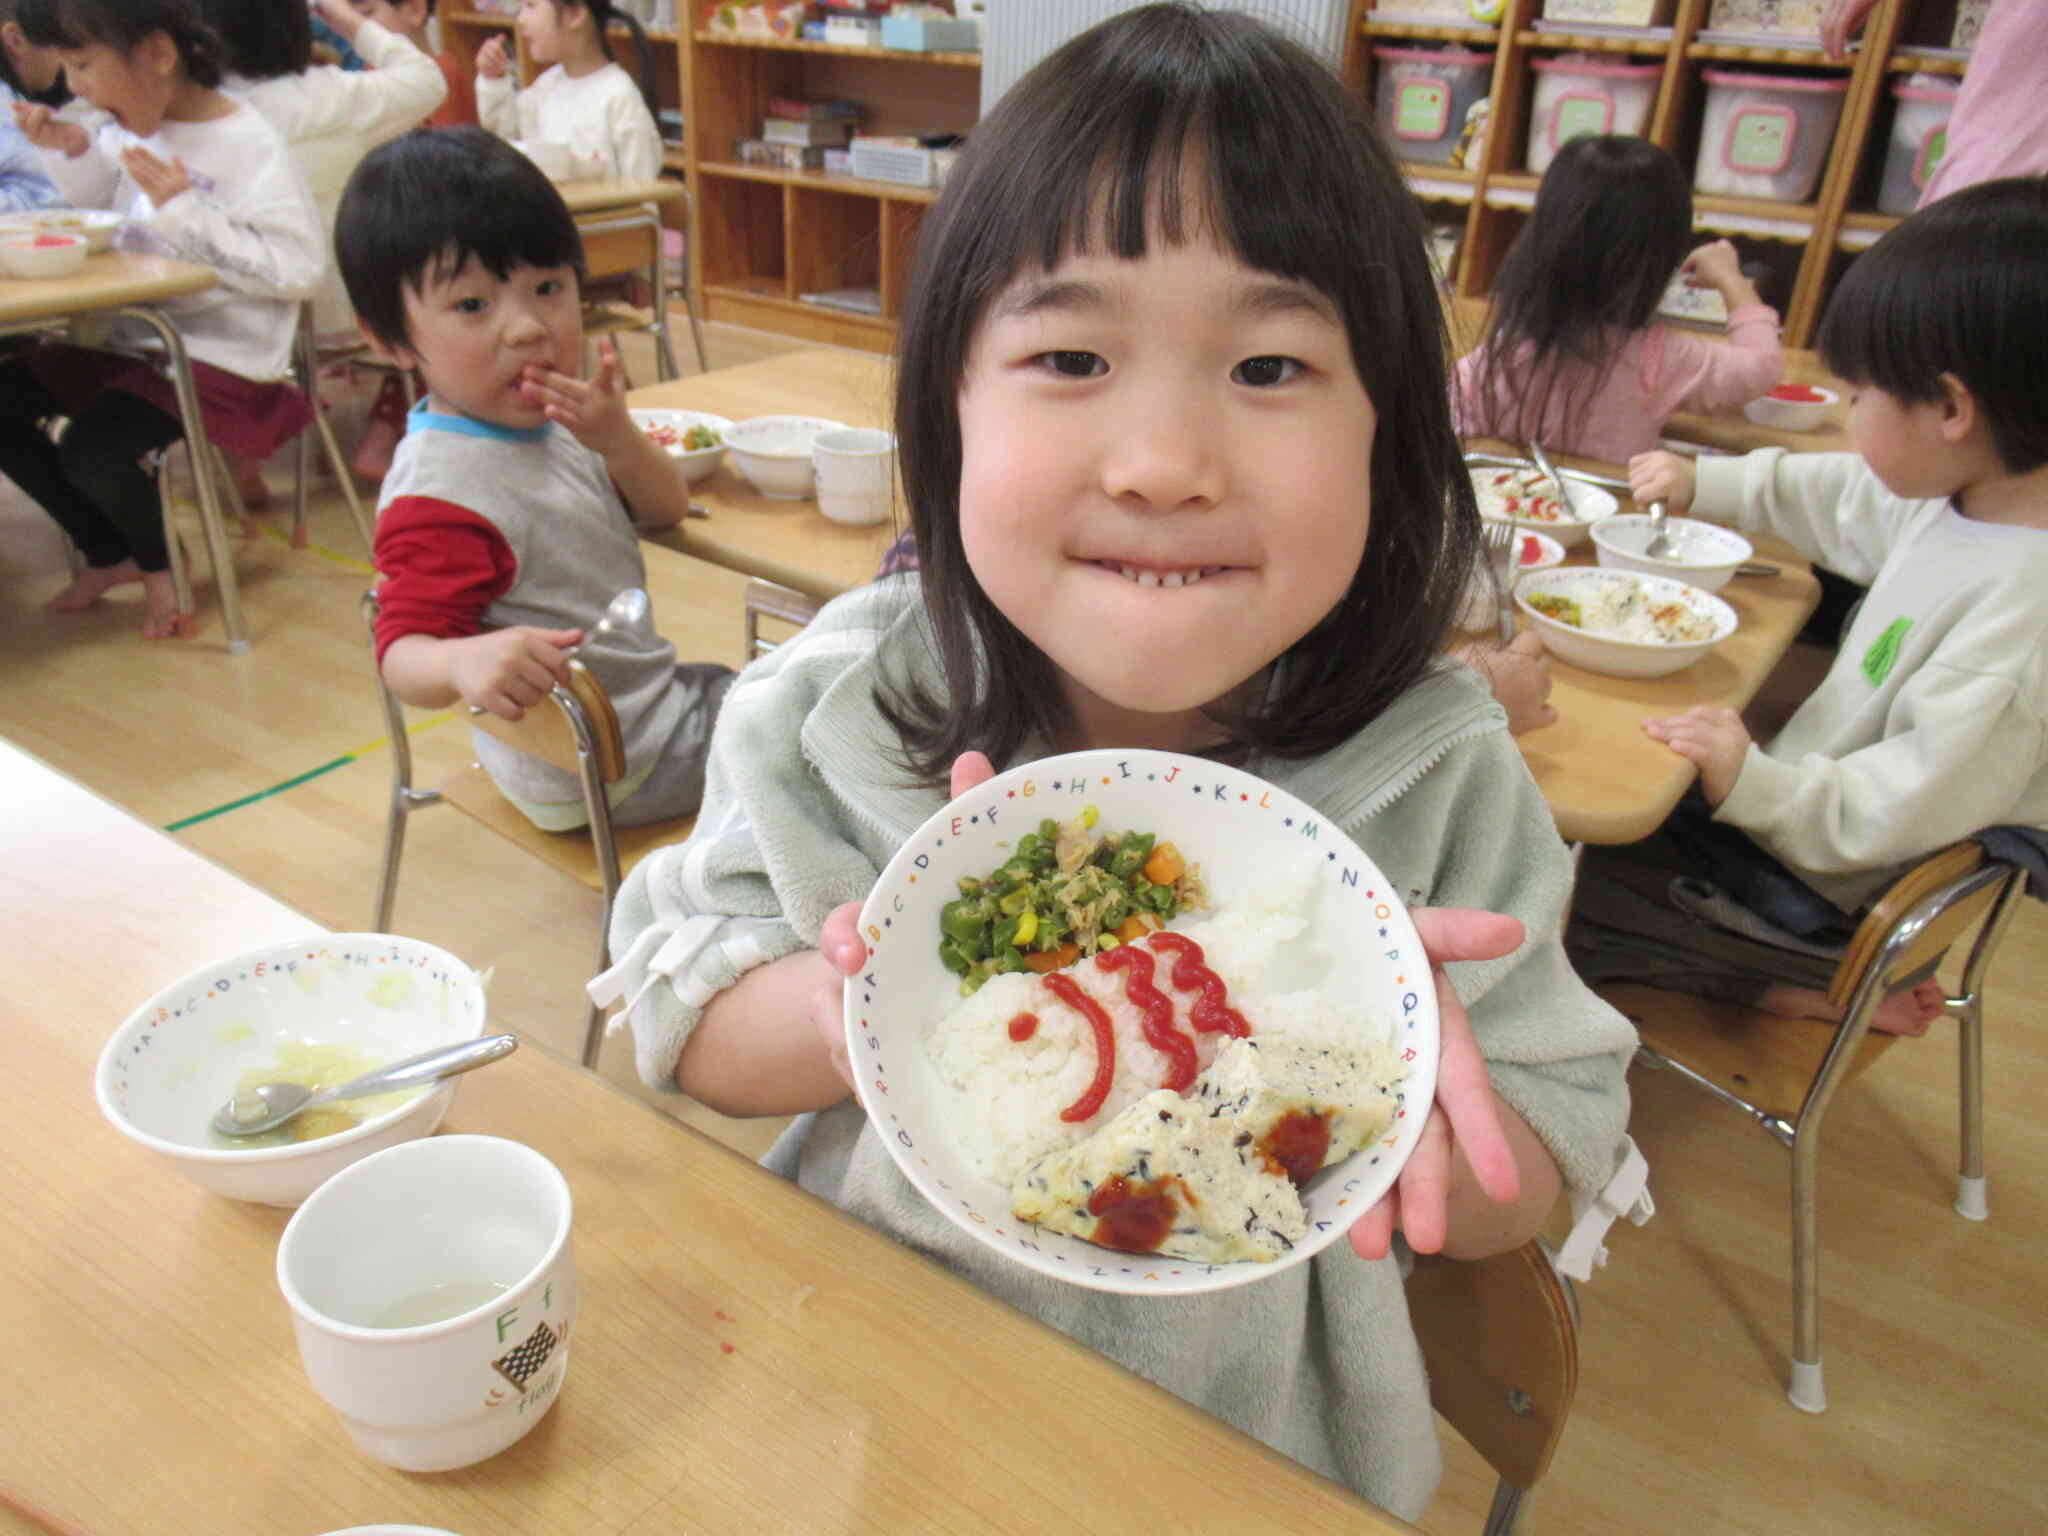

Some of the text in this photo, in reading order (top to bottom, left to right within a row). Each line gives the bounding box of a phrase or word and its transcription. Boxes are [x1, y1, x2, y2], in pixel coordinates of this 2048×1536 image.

[1117, 761, 1131, 778] I
[1164, 766, 1181, 783] J
[1023, 780, 1035, 797] G
[1070, 778, 1086, 794] H
[1214, 784, 1227, 801] K
[1259, 791, 1270, 809] L
[987, 805, 999, 824] F
[951, 817, 962, 835] E
[1301, 821, 1320, 840] M
[914, 853, 929, 869] D
[1342, 867, 1358, 887] N
[894, 894, 904, 912] C
[1375, 903, 1391, 920] O
[867, 924, 881, 942] B
[1384, 949, 1399, 960] P
[255, 962, 267, 977] E
[865, 973, 877, 987] A
[1402, 992, 1418, 1016] Q
[1400, 1048, 1417, 1062] R
[1315, 1221, 1333, 1232] V
[496, 1306, 519, 1343] F
